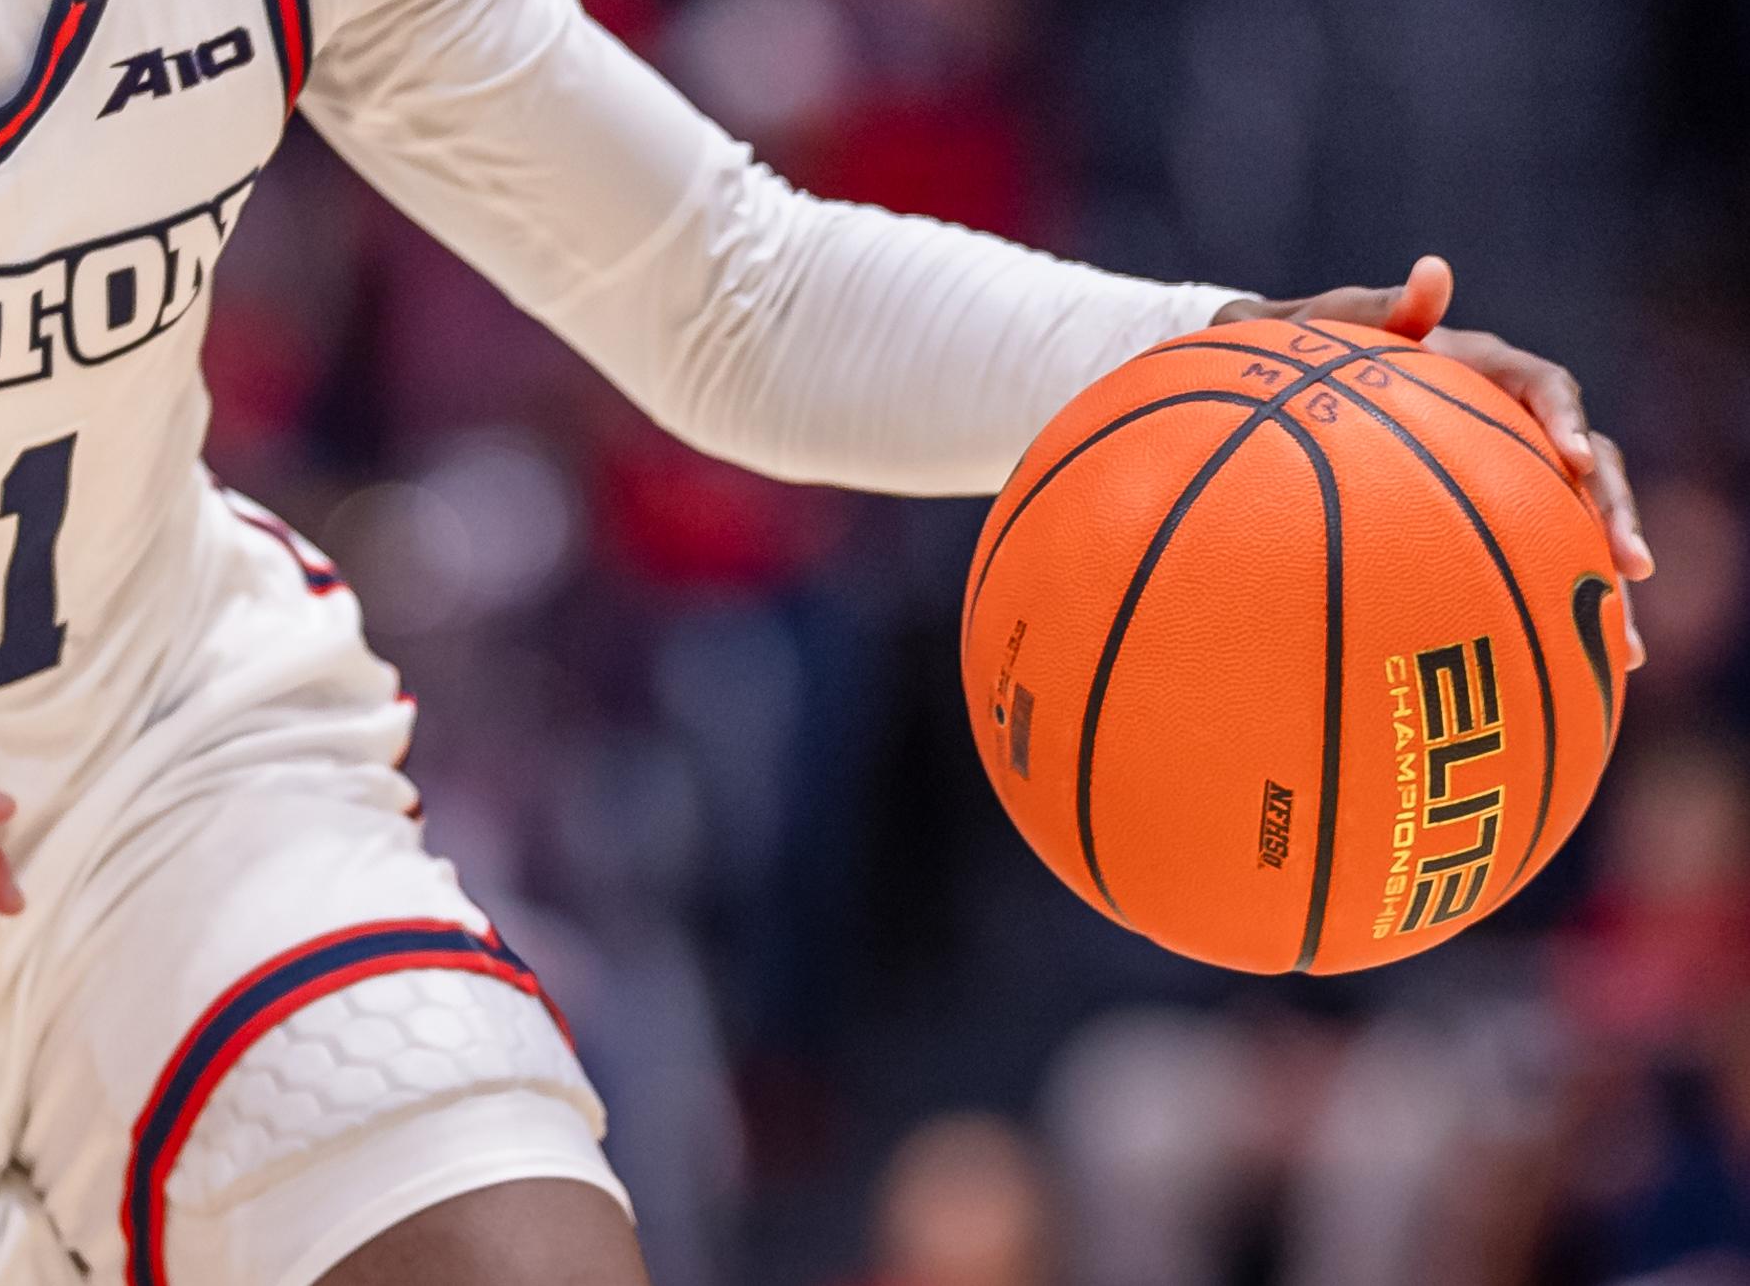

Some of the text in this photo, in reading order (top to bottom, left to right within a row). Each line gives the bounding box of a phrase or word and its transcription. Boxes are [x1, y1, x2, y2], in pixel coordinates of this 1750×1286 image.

[96, 26, 255, 121] A10
[1371, 654, 1418, 940] CHAMPIONSHIP
[1395, 634, 1506, 935] ELITE
